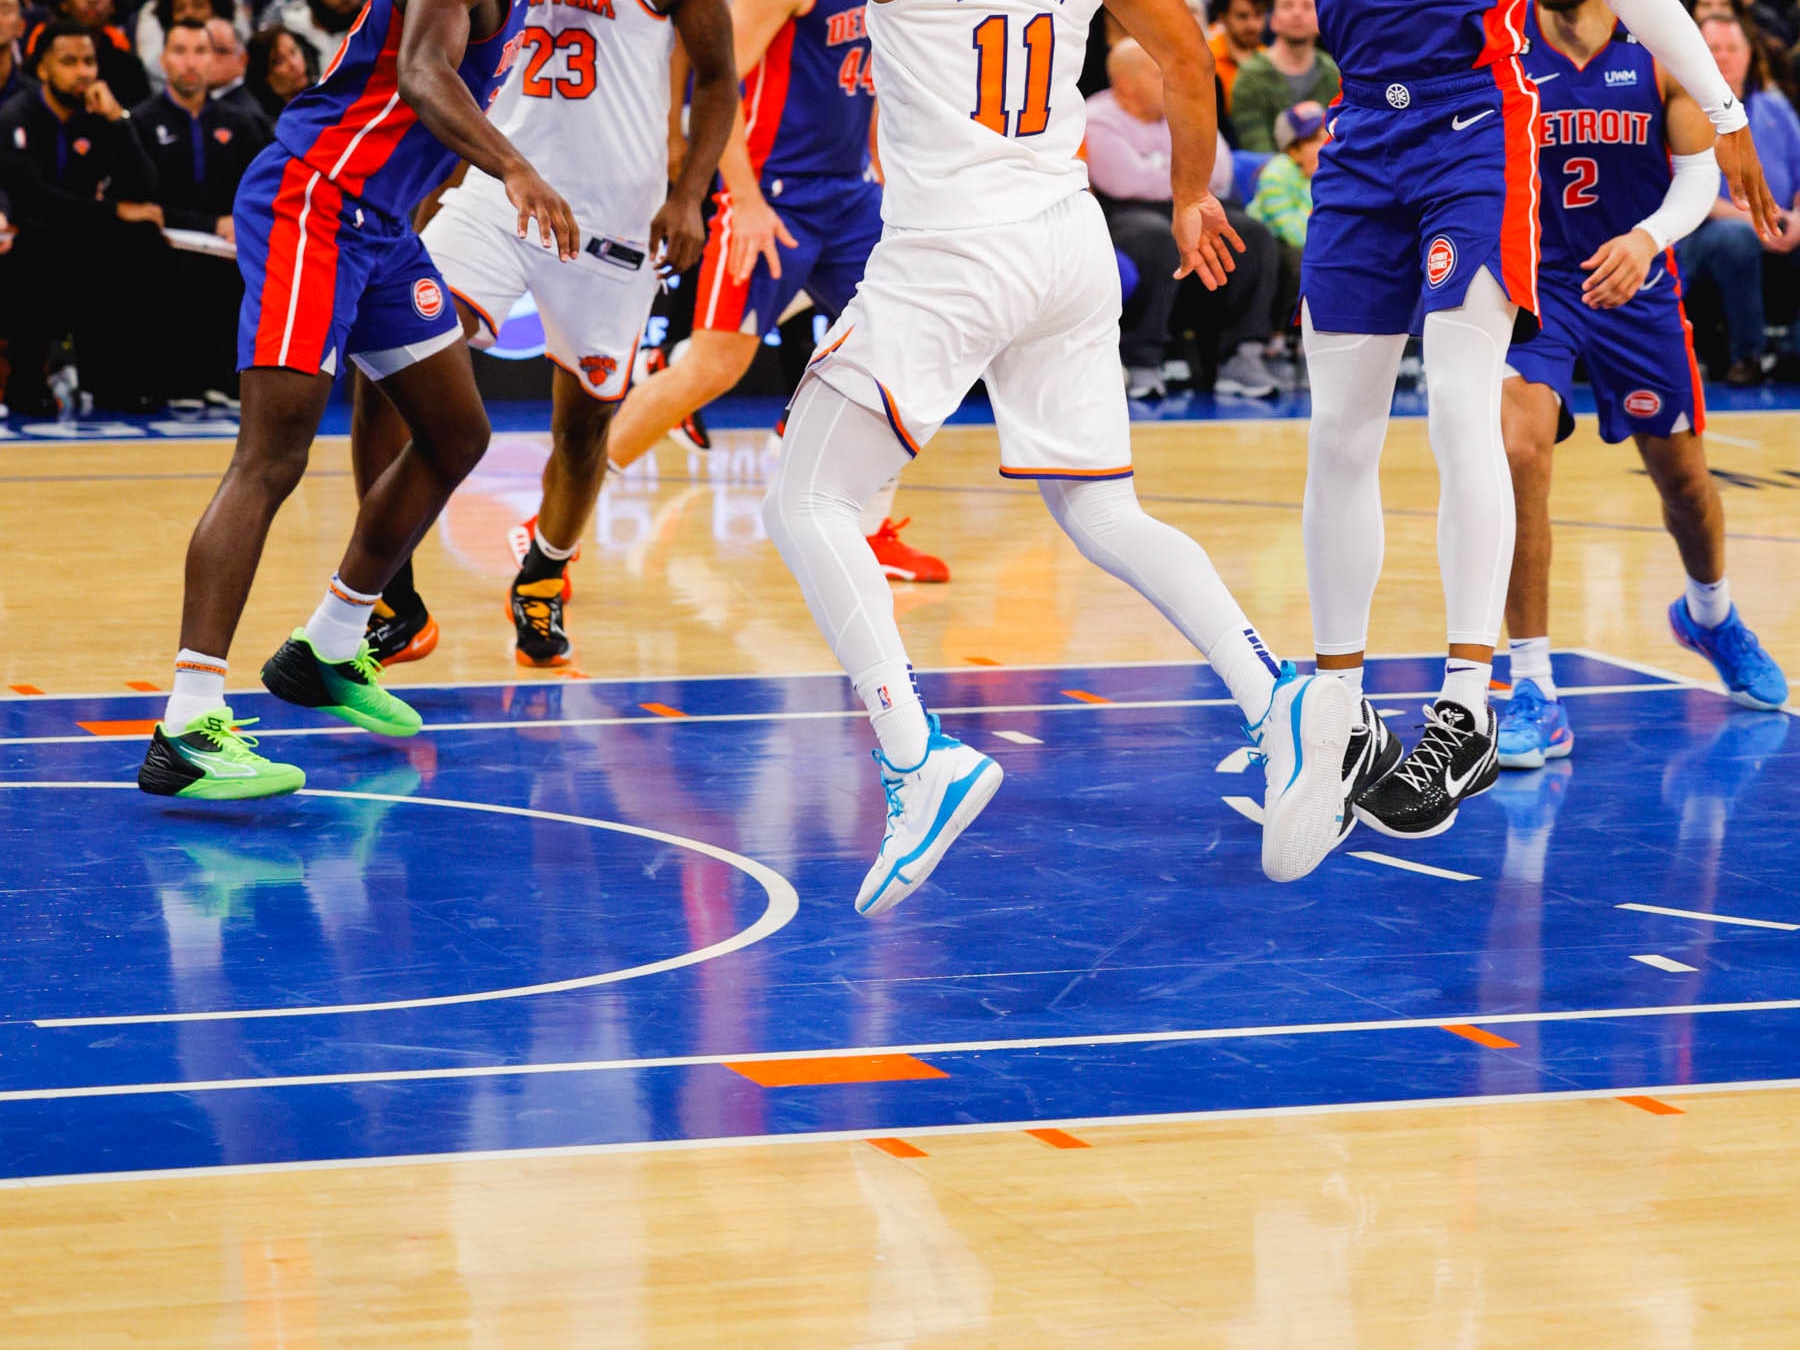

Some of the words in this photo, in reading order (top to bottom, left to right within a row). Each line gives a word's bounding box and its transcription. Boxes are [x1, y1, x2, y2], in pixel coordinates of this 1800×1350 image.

[521, 26, 597, 99] 23
[970, 12, 1055, 138] 11
[1604, 70, 1637, 83] UWM
[1563, 157, 1599, 209] 2
